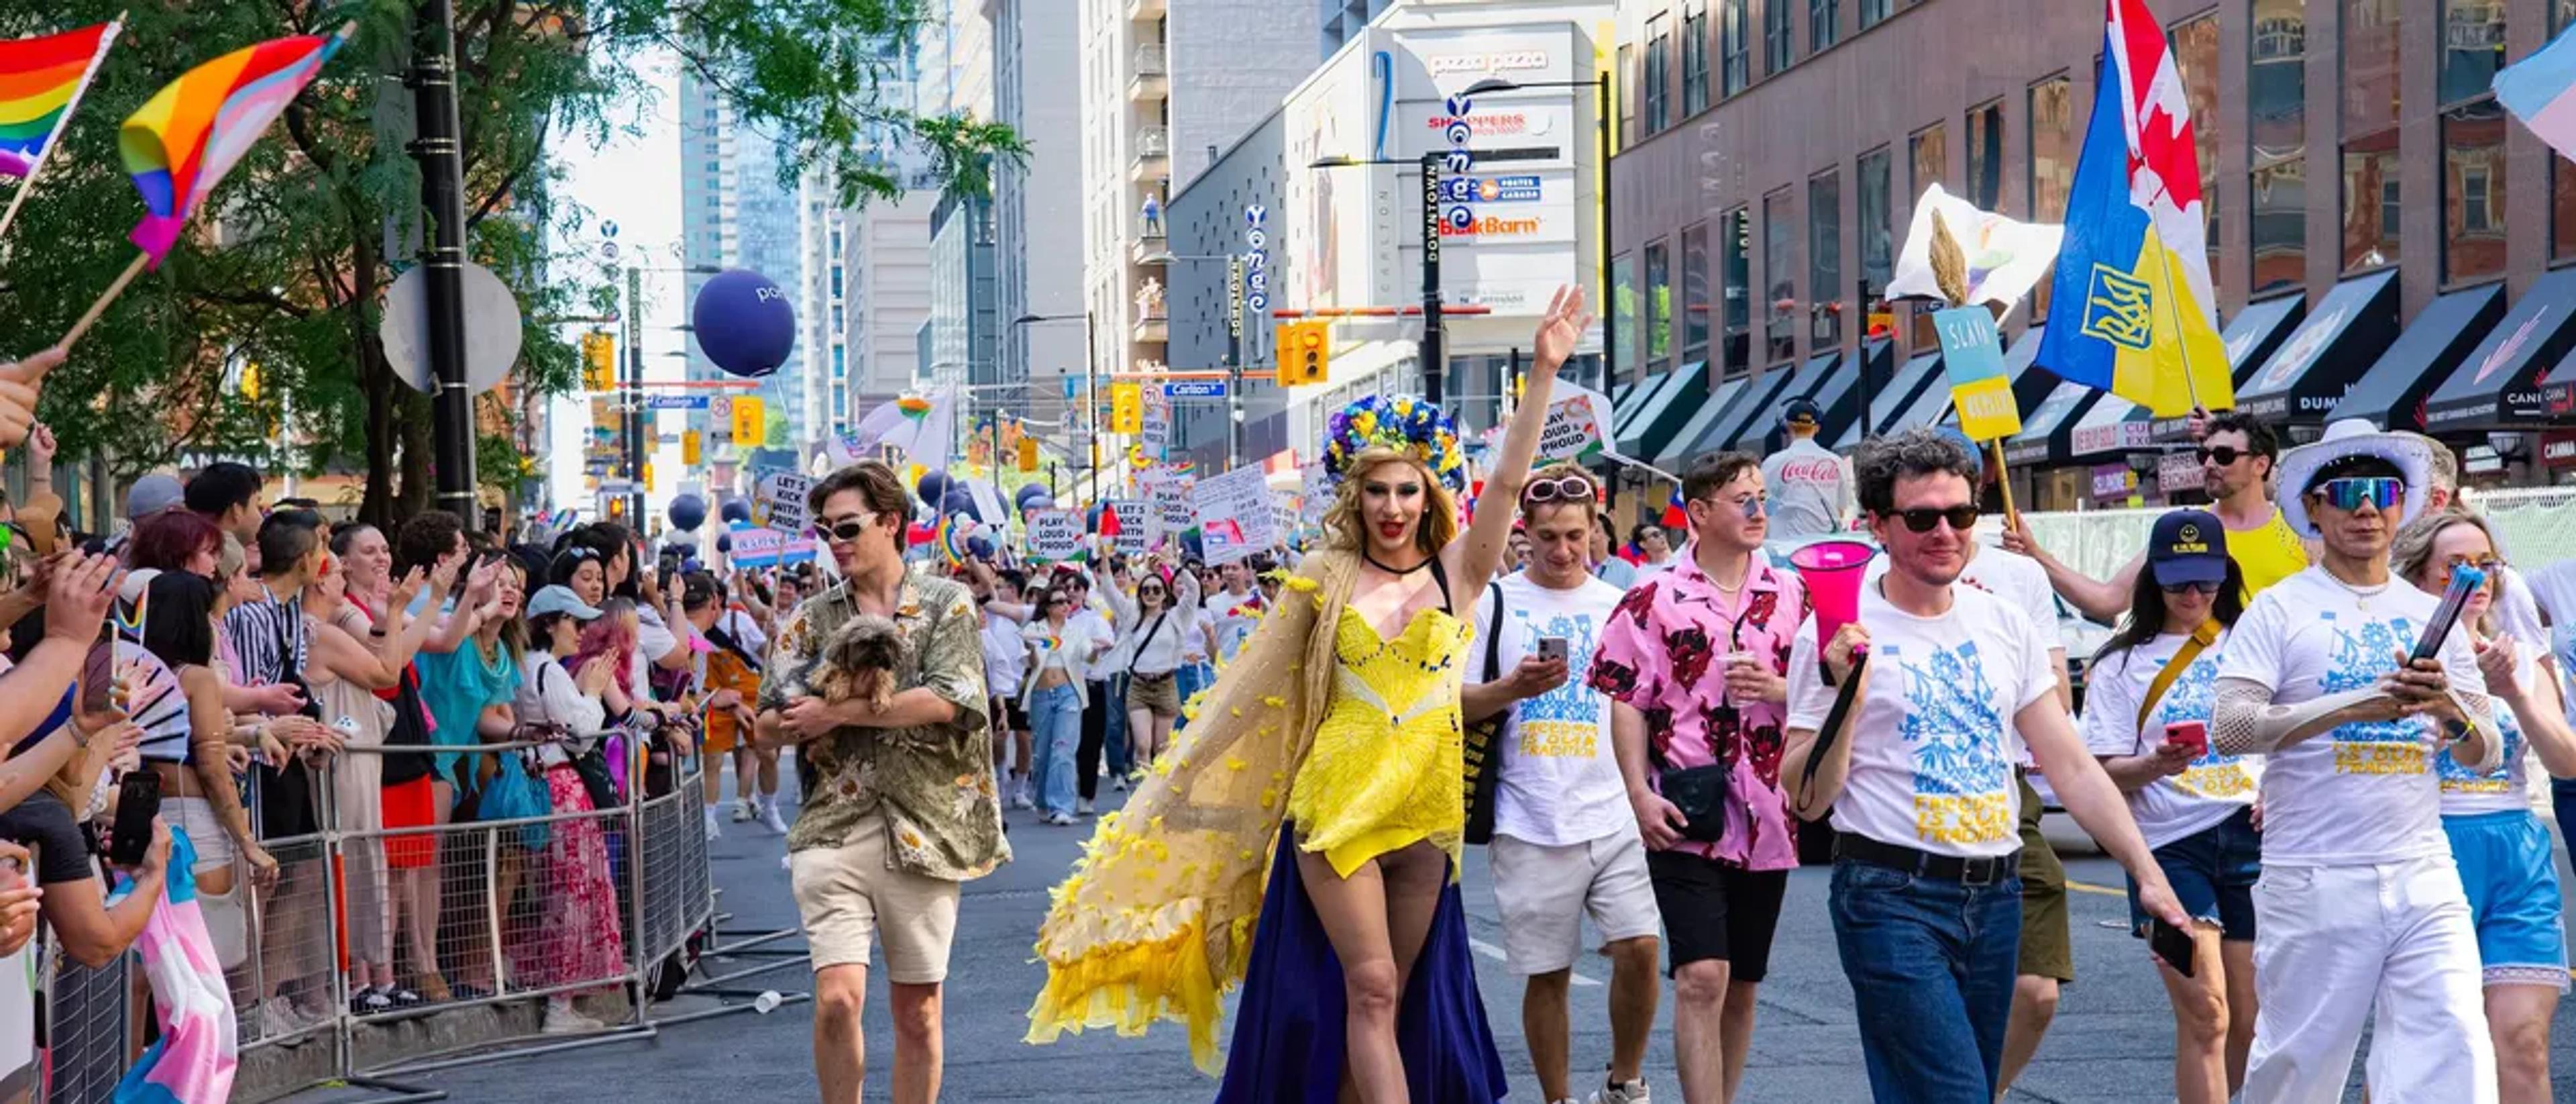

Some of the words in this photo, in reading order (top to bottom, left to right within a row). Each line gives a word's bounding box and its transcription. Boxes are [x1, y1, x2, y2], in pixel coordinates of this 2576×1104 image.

[1429, 113, 1525, 129] SHPPERS
[1447, 95, 1472, 229] Yonge
[1427, 164, 1438, 262] DOWNTOWN
[1379, 191, 1390, 293] CARLTON
[1246, 205, 1267, 313] Yonge
[1173, 383, 1210, 394] Carlton
[1541, 425, 1570, 440] OUD
[1542, 433, 1585, 454] PROUD
[776, 476, 806, 491] LETS
[776, 489, 802, 503] KICK
[773, 501, 802, 515] WITH
[1117, 505, 1144, 514] LETS
[769, 513, 802, 529] PRIDE
[1040, 517, 1064, 527] PLAY
[1164, 514, 1191, 524] ROUD
[1039, 530, 1065, 538] LOUD
[1039, 541, 1074, 550] PROUD
